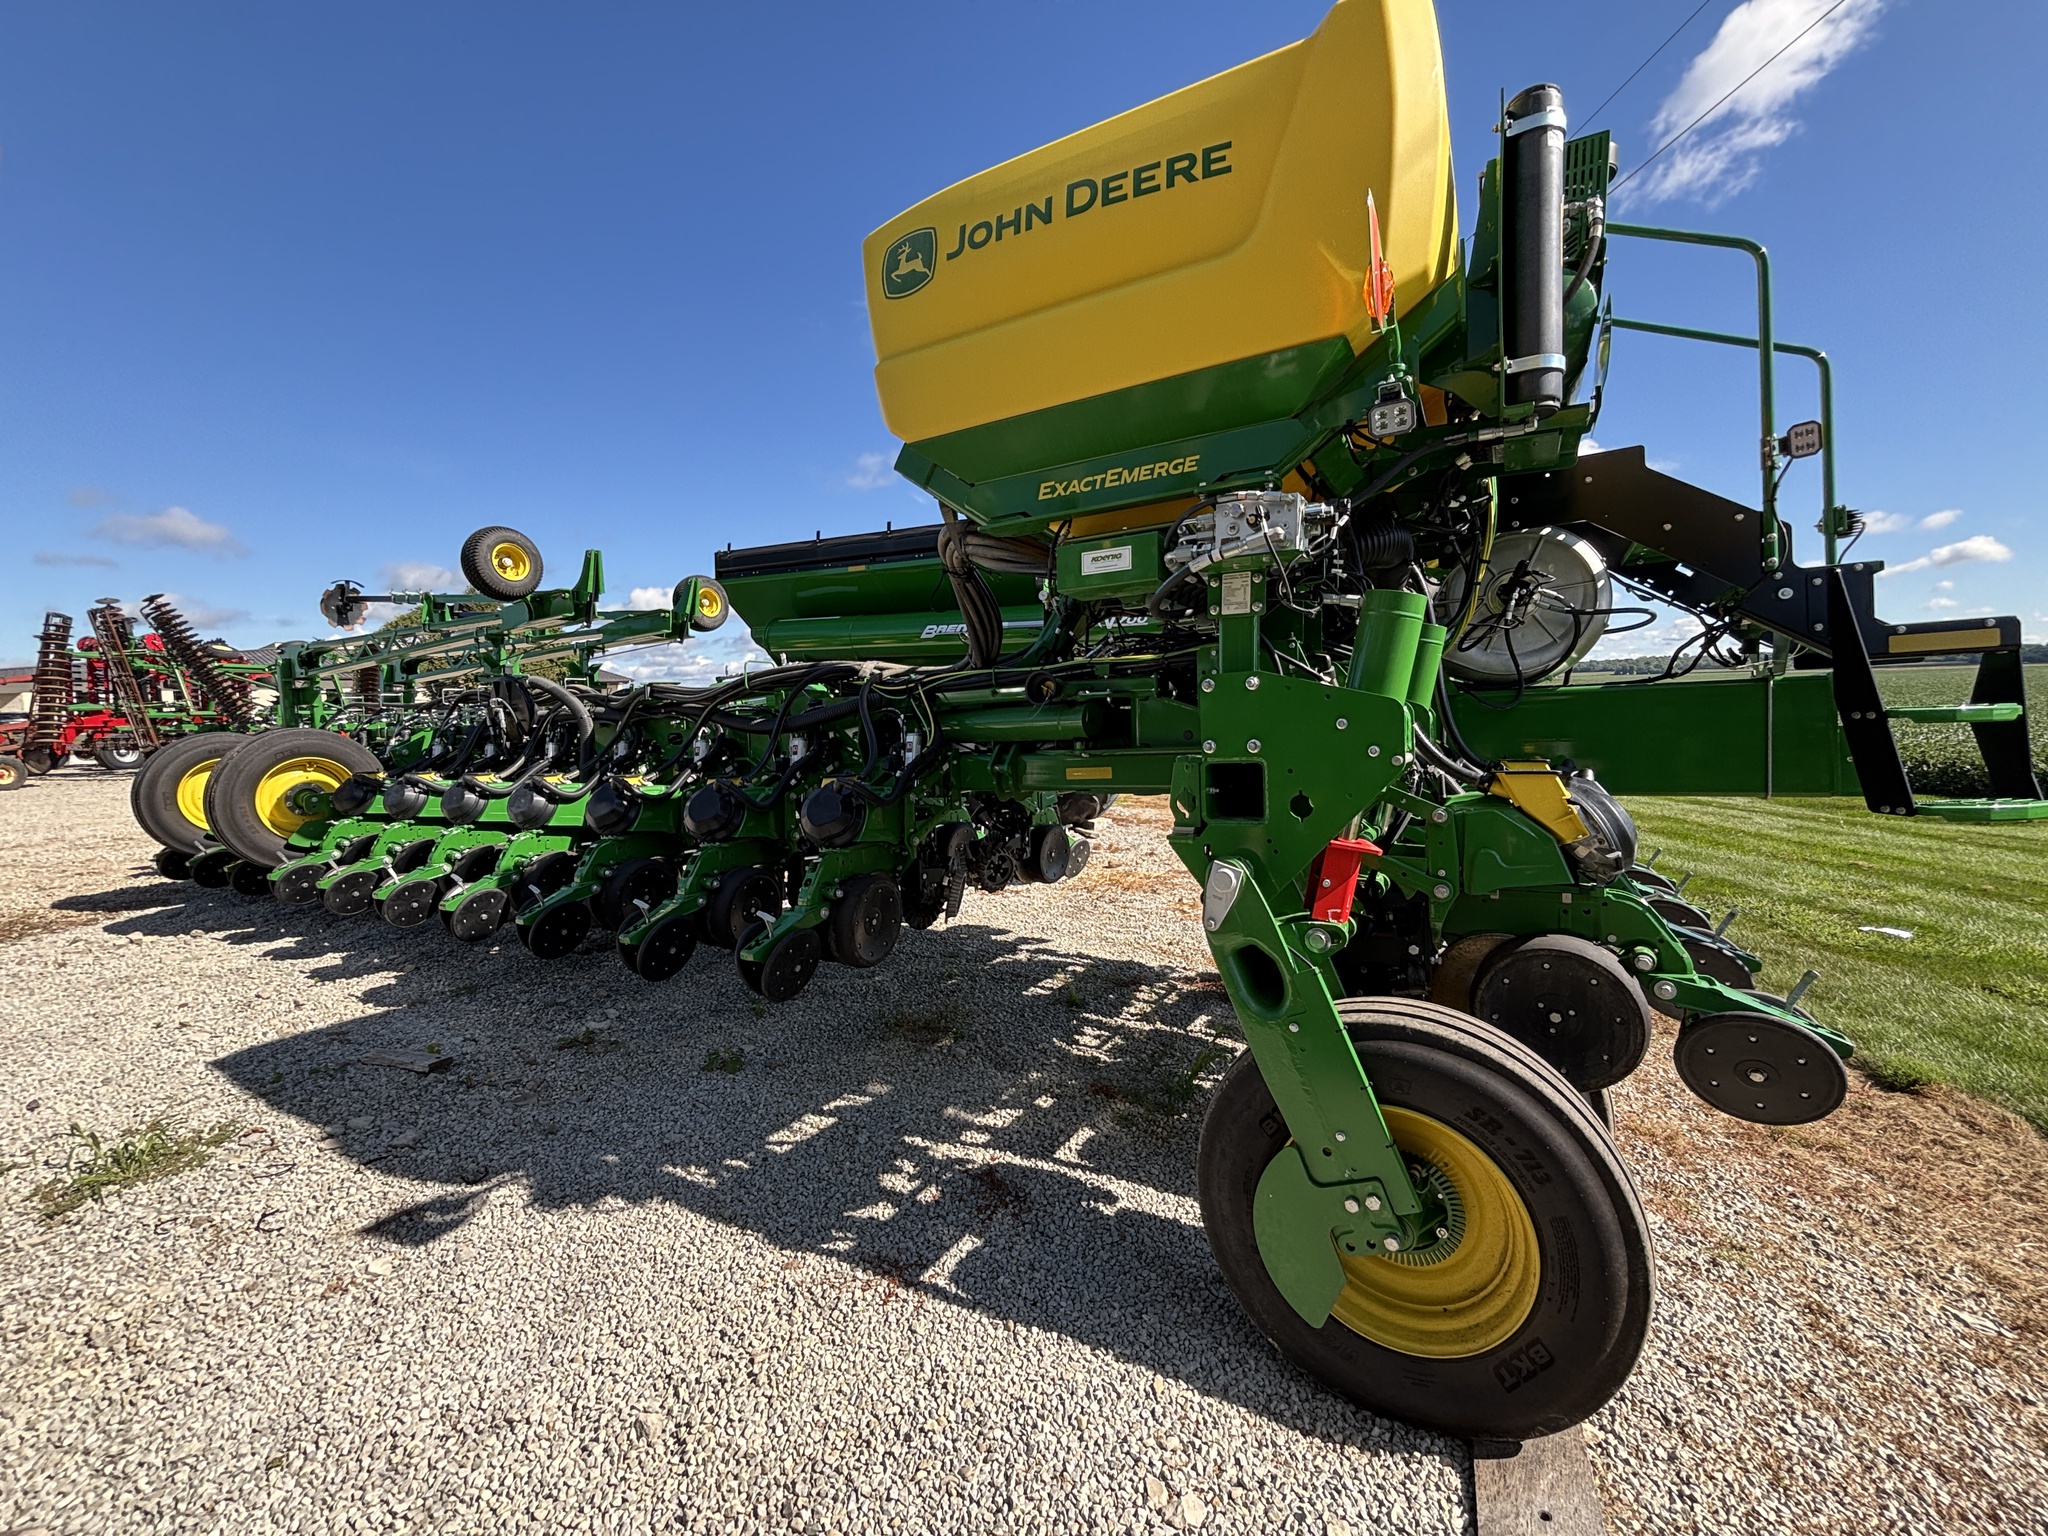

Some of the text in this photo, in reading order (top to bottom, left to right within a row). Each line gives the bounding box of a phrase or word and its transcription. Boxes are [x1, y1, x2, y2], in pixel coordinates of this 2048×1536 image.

[946, 140, 1233, 261] JOHN DEERE
[1498, 1341, 1553, 1389] BKT
